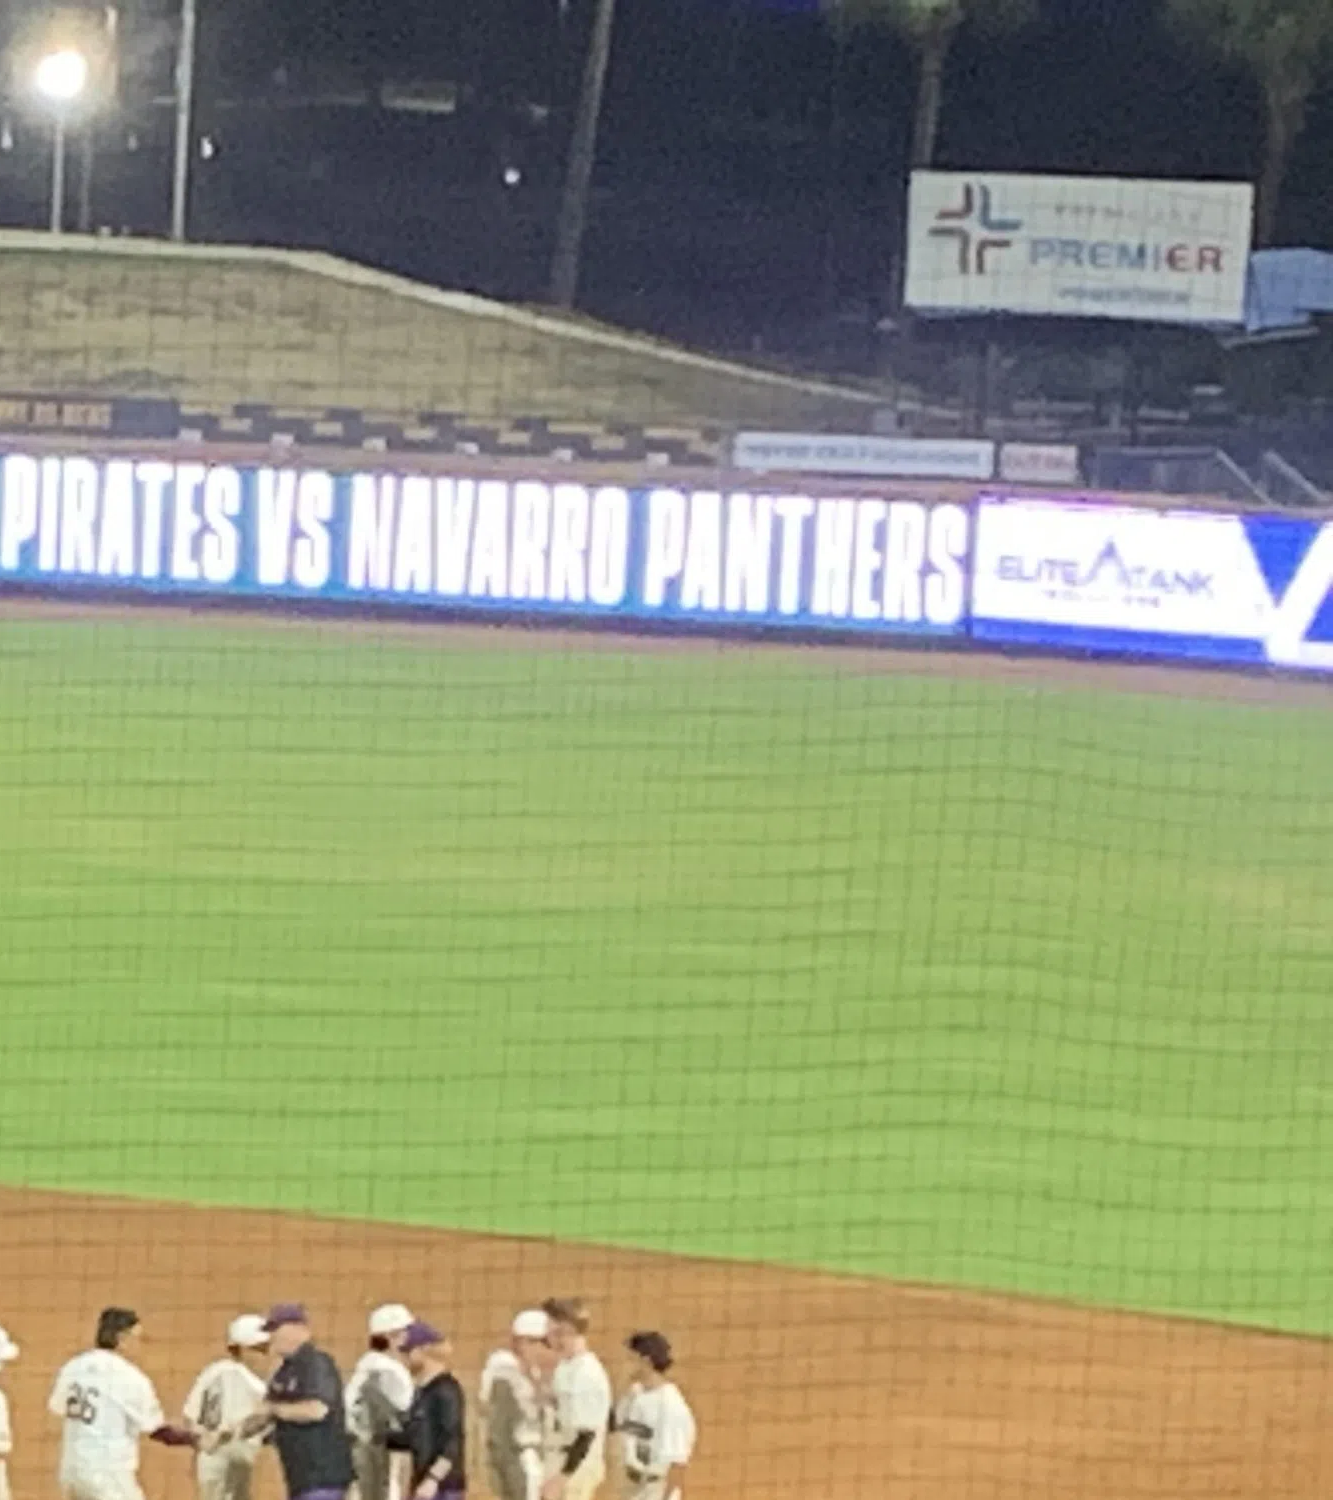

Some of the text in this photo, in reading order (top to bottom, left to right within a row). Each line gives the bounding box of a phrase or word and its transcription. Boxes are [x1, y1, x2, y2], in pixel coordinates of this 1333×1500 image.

[1029, 237, 1223, 273] PREMIER
[0, 454, 241, 584] PIRATES
[257, 468, 333, 588] VS
[347, 472, 629, 605] NAVARRO
[643, 489, 968, 624] PANTHERS
[65, 1382, 100, 1425] 26
